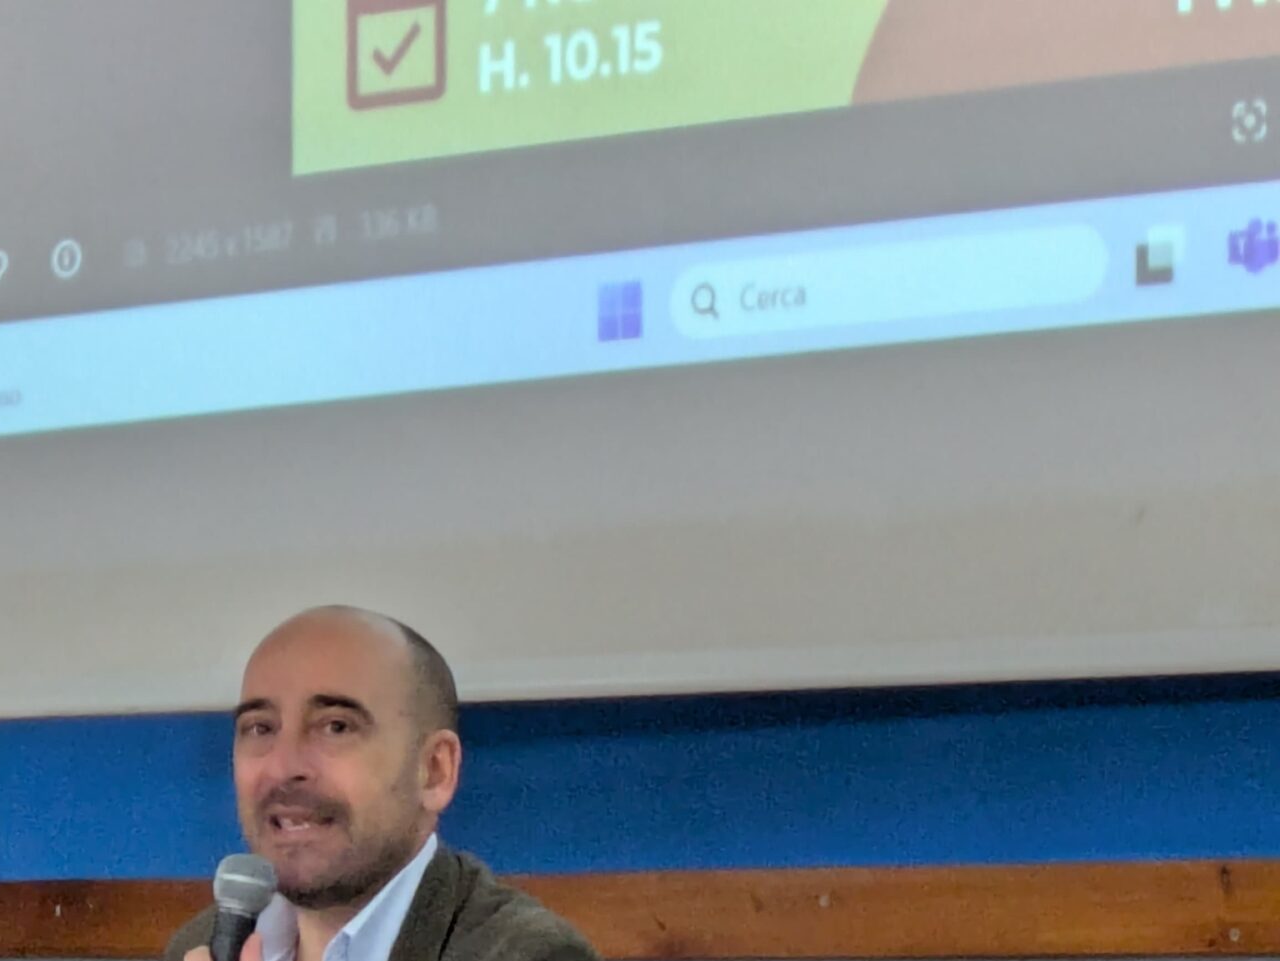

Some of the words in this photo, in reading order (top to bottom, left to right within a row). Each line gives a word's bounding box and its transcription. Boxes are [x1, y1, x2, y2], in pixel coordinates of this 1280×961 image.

[479, 40, 529, 93] H.
[544, 20, 663, 84] 10.15
[739, 281, 807, 312] Cerca
